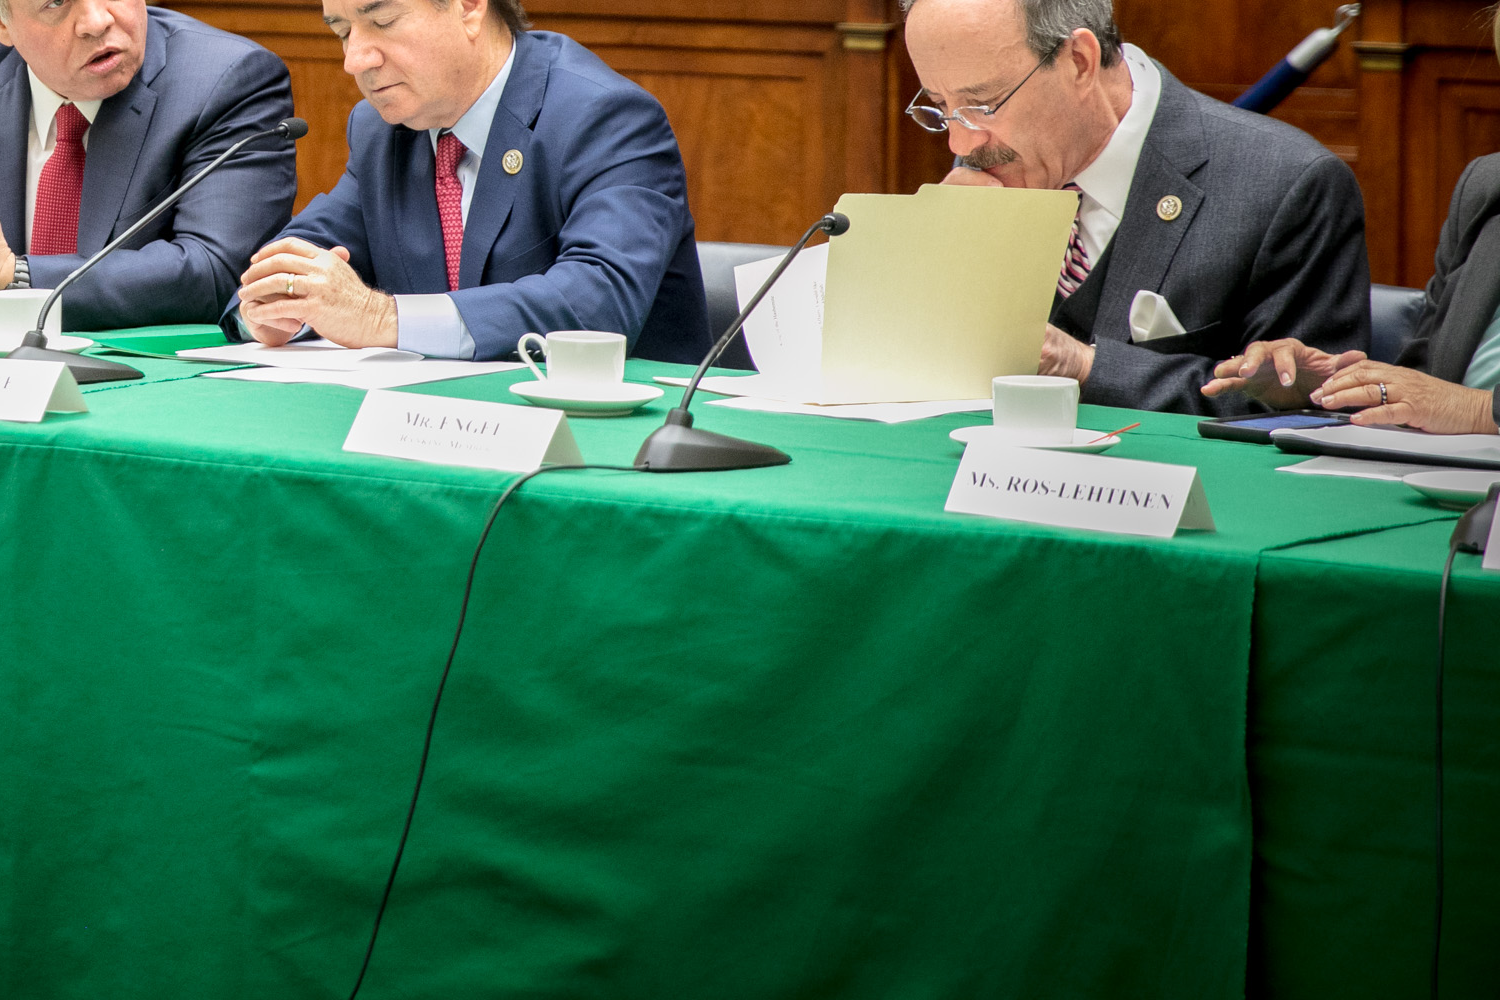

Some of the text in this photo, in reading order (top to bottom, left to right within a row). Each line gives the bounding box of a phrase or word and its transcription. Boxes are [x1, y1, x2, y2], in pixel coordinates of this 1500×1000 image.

[405, 411, 434, 429] MR.
[969, 471, 1174, 510] MS. ROS-LEHTINEN
